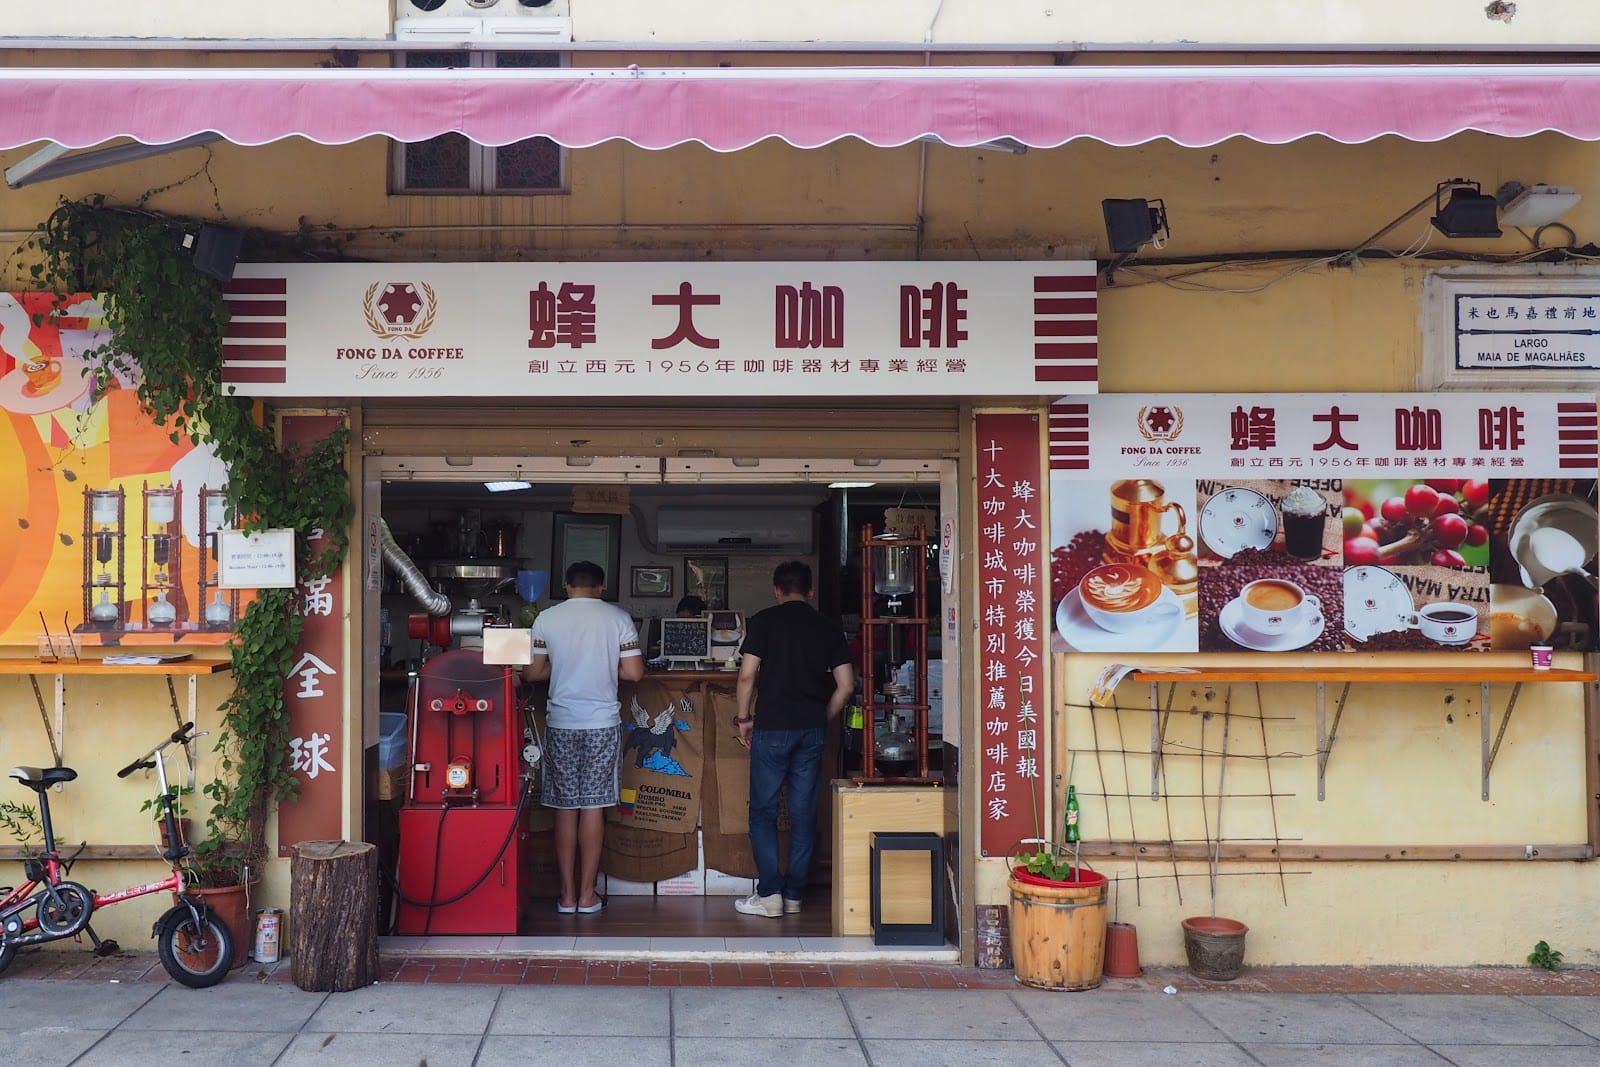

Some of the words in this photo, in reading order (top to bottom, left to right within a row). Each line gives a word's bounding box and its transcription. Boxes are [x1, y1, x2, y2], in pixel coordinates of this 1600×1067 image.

[528, 281, 968, 349] 蜂大咖啡
[1468, 306, 1597, 320] 米也馬嘉禮前地
[1514, 338, 1548, 348] LARGO
[336, 348, 376, 360] FONG
[381, 348, 403, 360] DA
[408, 348, 464, 360] COFFEE
[1477, 353, 1502, 361] MAIA
[1507, 353, 1520, 361] DE
[1525, 350, 1585, 361] MAGALHÃES
[355, 363, 398, 380] Since
[408, 366, 445, 380] 1956
[528, 359, 967, 373] 創立西元1956年咖啡器材專業經營
[1230, 405, 1525, 451] 蜂大咖啡
[1133, 456, 1160, 467] Since
[1230, 457, 1525, 467] 創立西元1956年咖啡器材專業經營
[983, 439, 1009, 821] 十大咖啡城市特別推薦咖啡店家
[1012, 479, 1040, 778] 蜂大咖啡榮獲今日美國報
[639, 785, 691, 800] COLOMBIA
